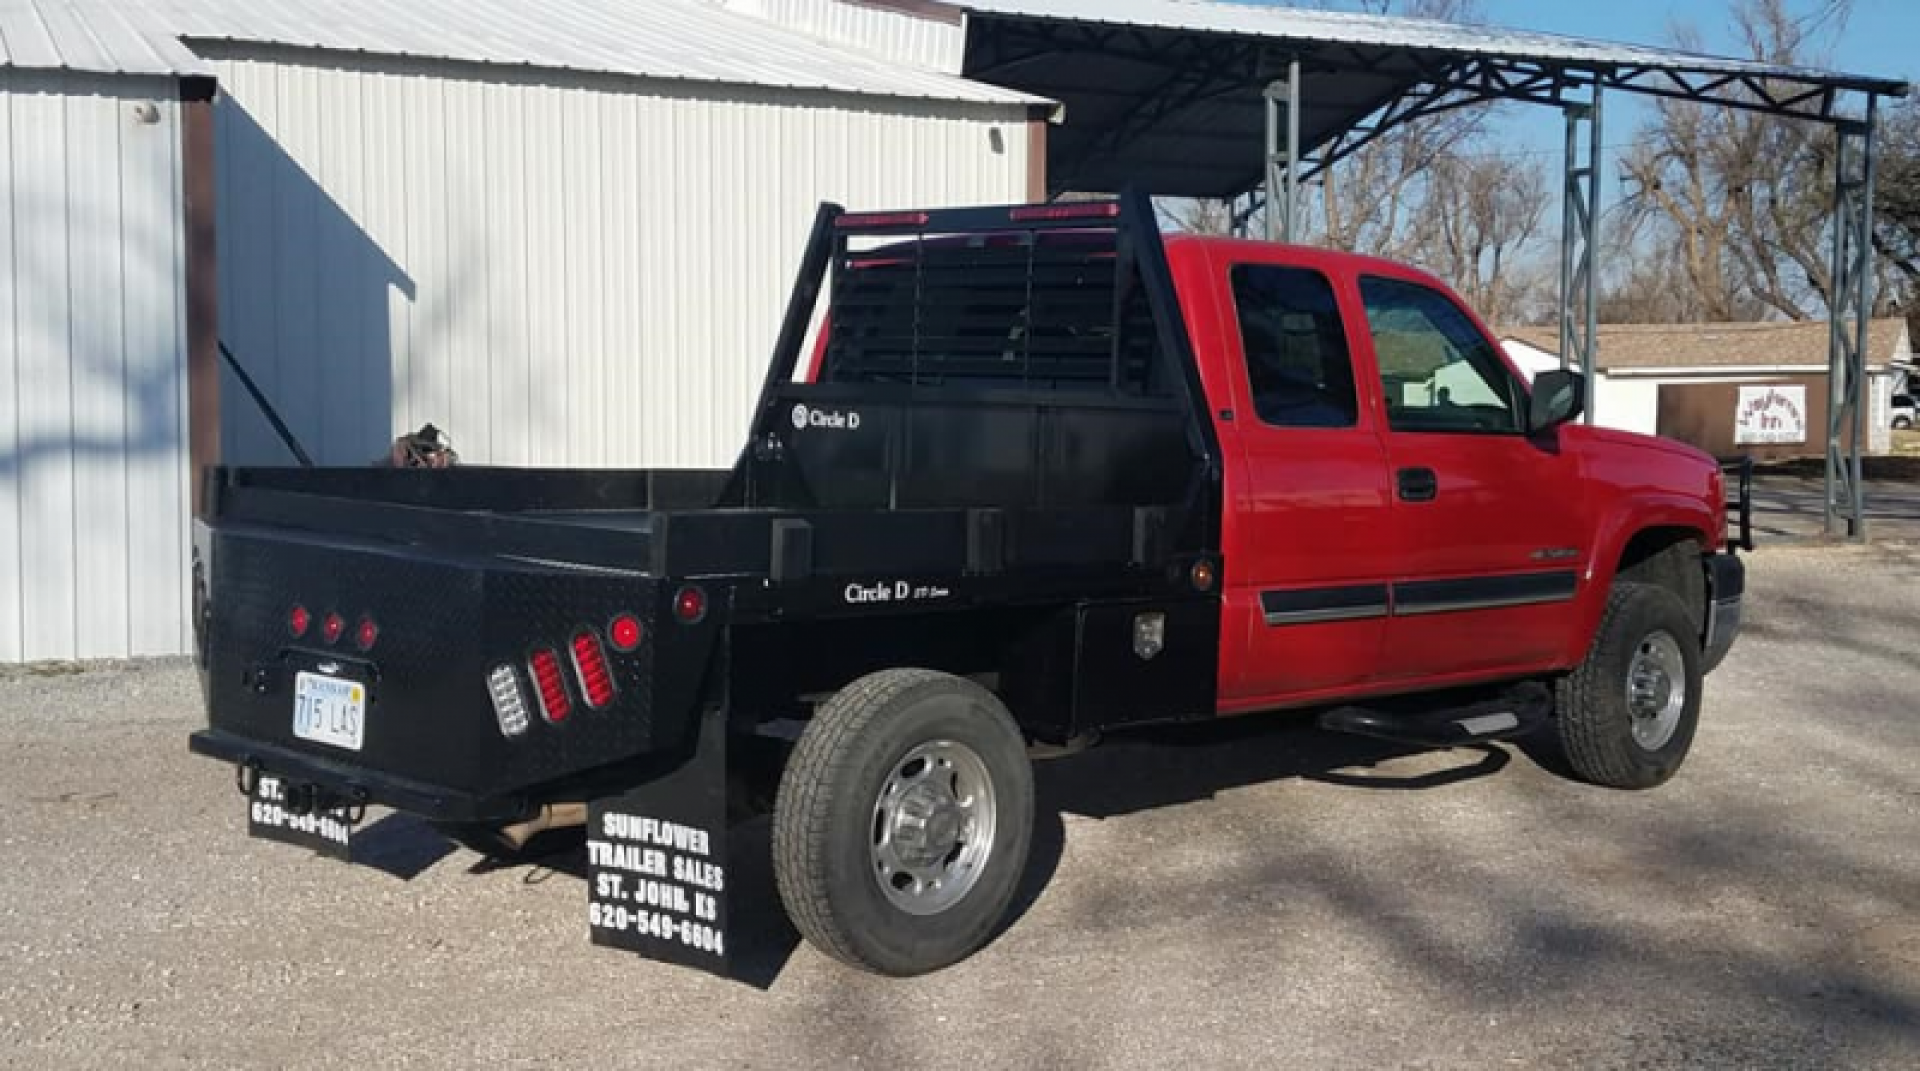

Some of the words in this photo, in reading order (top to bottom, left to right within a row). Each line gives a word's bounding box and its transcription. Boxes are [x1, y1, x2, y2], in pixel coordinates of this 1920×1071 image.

[810, 409, 845, 428] Circle
[847, 411, 860, 430] D
[845, 580, 891, 603] Circle
[895, 580, 910, 601] D
[603, 811, 710, 856] SUNFLOWER
[586, 840, 667, 877] TRAILER
[673, 854, 724, 892] SALES
[597, 872, 629, 899] ST.
[589, 902, 724, 957] 620-549-6604
